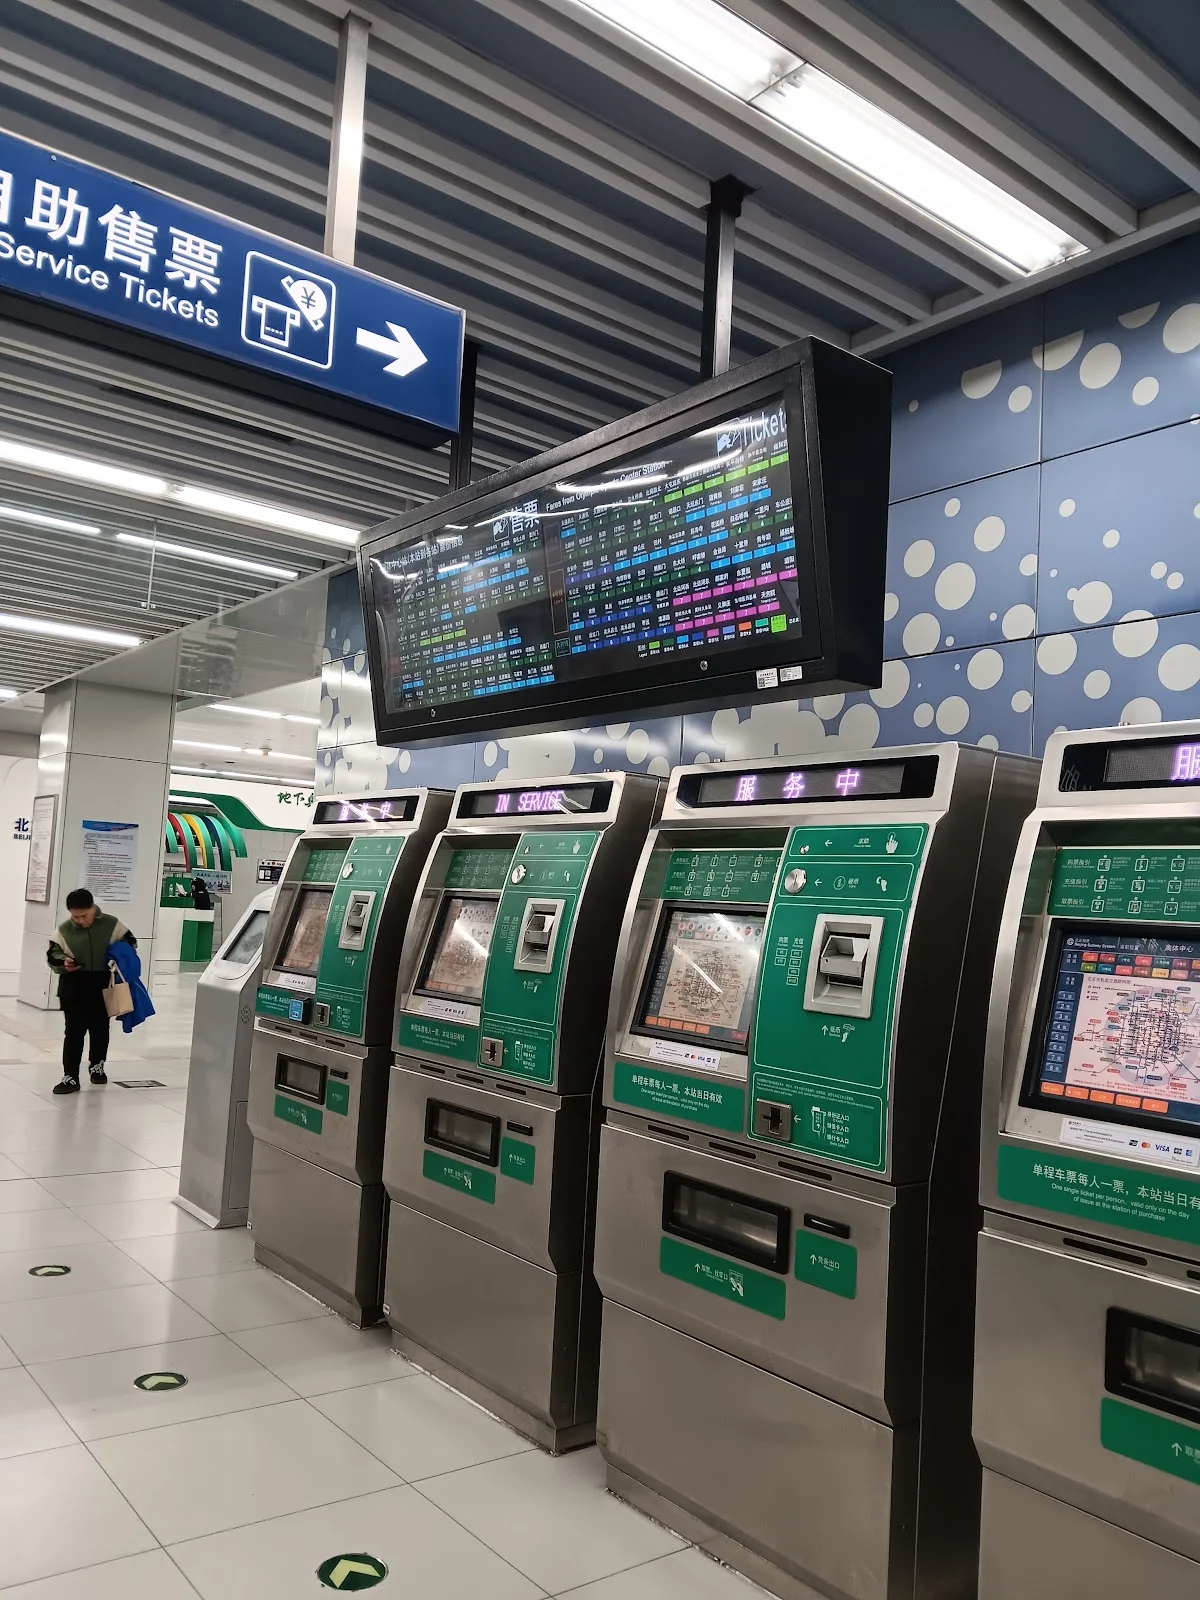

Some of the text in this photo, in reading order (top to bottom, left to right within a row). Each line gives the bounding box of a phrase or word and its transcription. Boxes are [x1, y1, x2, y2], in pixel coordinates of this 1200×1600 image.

[0, 232, 219, 328] Service Tickets
[546, 500, 562, 512] Fares
[642, 461, 666, 475] Station
[510, 499, 540, 535] 售票
[495, 789, 565, 813] IN SERVICE
[735, 768, 860, 801] 服务中
[1164, 944, 1194, 953] 奥体中心
[1155, 1144, 1170, 1153] VISA
[1052, 1183, 1063, 1191] One
[1145, 1204, 1157, 1213] only
[1178, 1211, 1190, 1219] day
